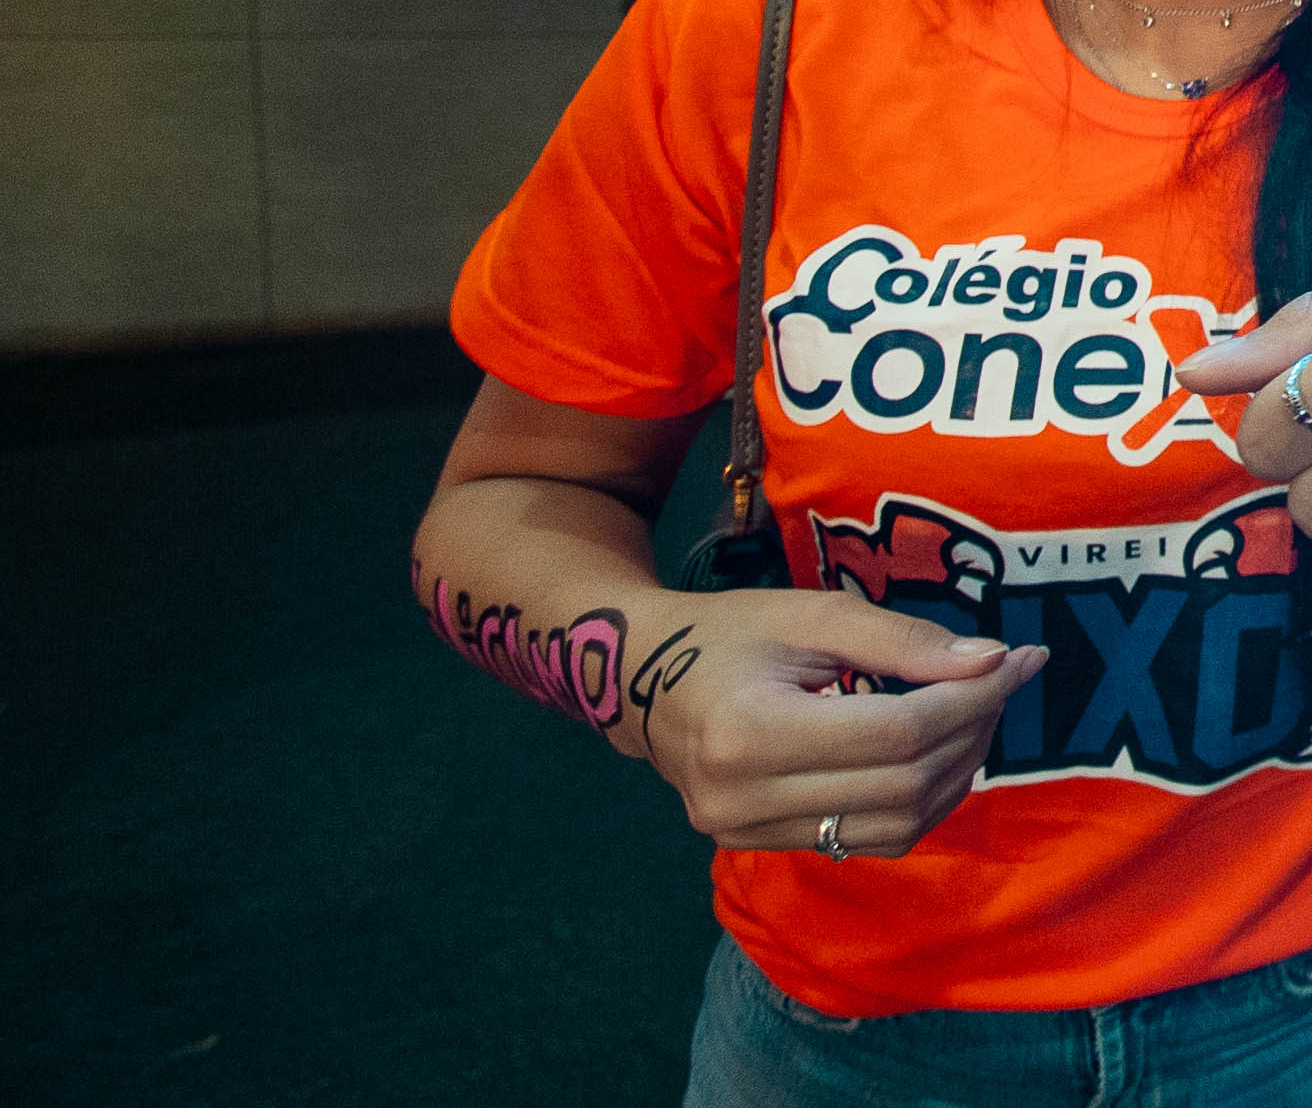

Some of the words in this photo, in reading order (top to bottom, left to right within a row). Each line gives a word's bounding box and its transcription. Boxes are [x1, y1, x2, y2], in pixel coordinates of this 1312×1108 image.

[808, 237, 1139, 322] Colégio
[1017, 536, 1168, 568] VIREI
[889, 588, 1304, 771] IXO
